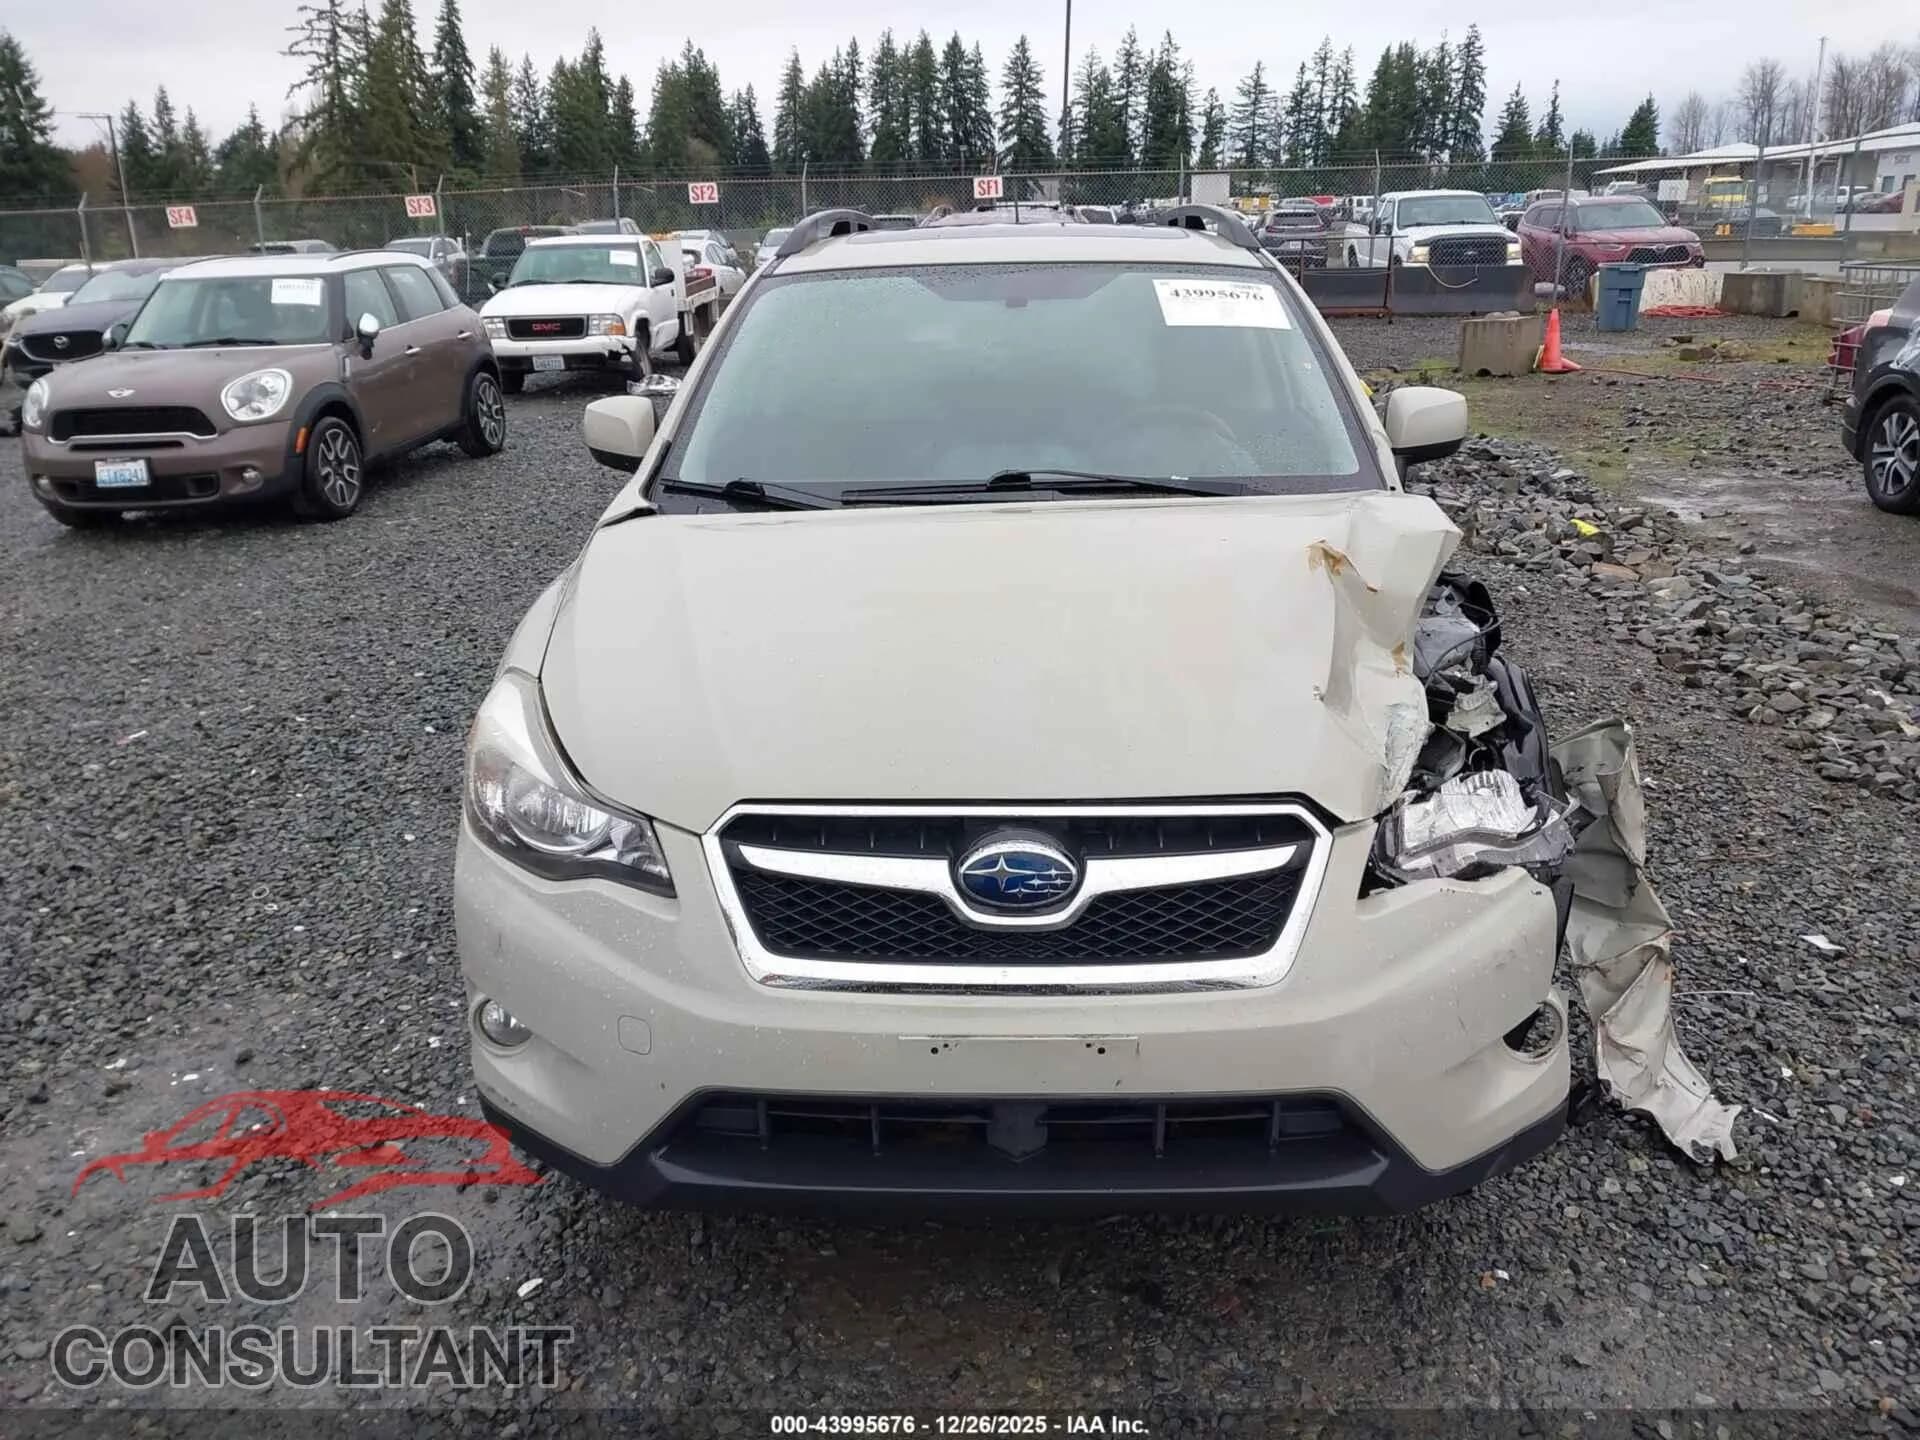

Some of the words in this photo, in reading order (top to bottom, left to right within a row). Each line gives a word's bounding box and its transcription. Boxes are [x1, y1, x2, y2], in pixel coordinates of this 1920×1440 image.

[691, 185, 716, 201] SF2
[978, 179, 999, 196] SF1
[408, 198, 433, 214] SF3
[169, 208, 194, 225] SF4
[1170, 288, 1264, 301] 43995676
[532, 323, 561, 331] GMC
